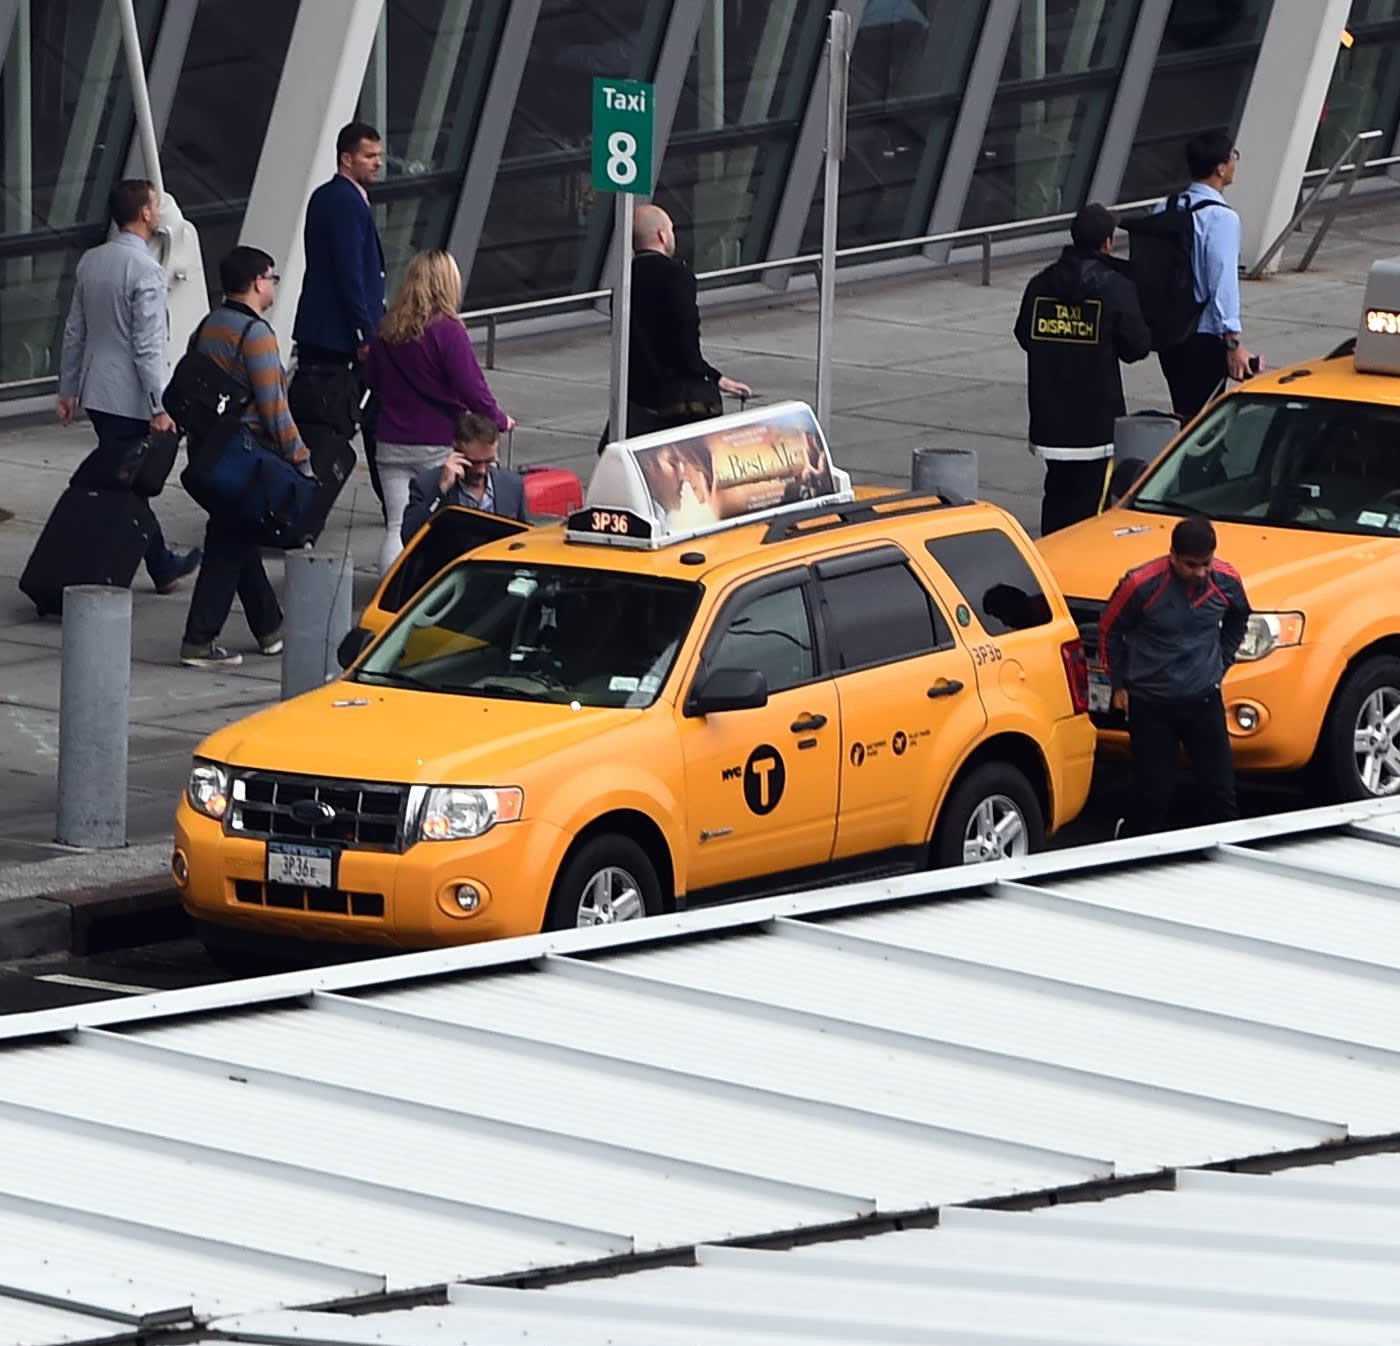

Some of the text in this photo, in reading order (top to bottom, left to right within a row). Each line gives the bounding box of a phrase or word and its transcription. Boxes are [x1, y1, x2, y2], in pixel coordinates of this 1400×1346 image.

[602, 86, 646, 113] Taxi
[607, 131, 638, 185] 8
[1055, 303, 1082, 321] TAXI
[1038, 318, 1094, 337] DISPATCH
[726, 451, 766, 481] Best
[591, 511, 629, 534] 3P36
[721, 766, 743, 782] NYC
